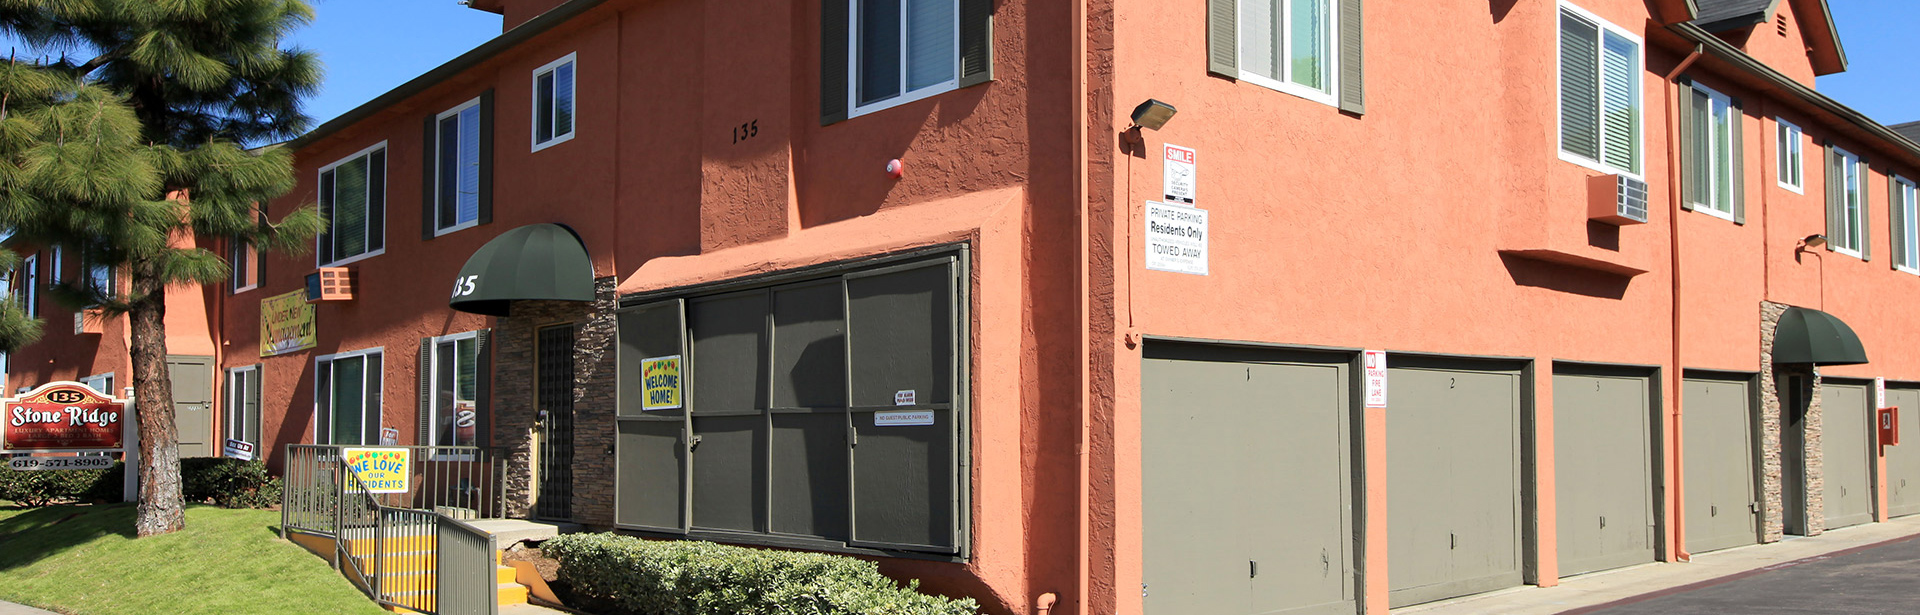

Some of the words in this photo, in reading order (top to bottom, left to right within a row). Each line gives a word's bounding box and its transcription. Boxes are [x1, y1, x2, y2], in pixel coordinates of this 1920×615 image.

[733, 119, 758, 145] 135
[1167, 148, 1193, 164] SMILE
[1150, 207, 1175, 220] PRIVATE
[1177, 212, 1203, 224] PARKING
[1150, 220, 1185, 237] Residents
[1187, 226, 1203, 241] Only
[1152, 243, 1180, 257] TOWED
[1182, 247, 1202, 259] AWAY
[271, 310, 289, 325] UNDER
[289, 304, 304, 320] NEW
[1367, 354, 1375, 368] NO
[645, 374, 677, 390] WELCOME
[1246, 367, 1250, 382] 1
[1372, 379, 1381, 387] FIRE
[1450, 377, 1455, 389] 2
[1596, 380, 1600, 391] 3
[52, 392, 80, 401] 135
[650, 389, 673, 405] HOME!
[1371, 389, 1381, 397] LANE
[11, 405, 61, 427] Stone
[63, 406, 118, 427] Ridge
[12, 459, 109, 468] 619-571-8905
[350, 460, 370, 474] WE
[373, 459, 403, 474] LOVE
[349, 480, 403, 489] SIDENTS
